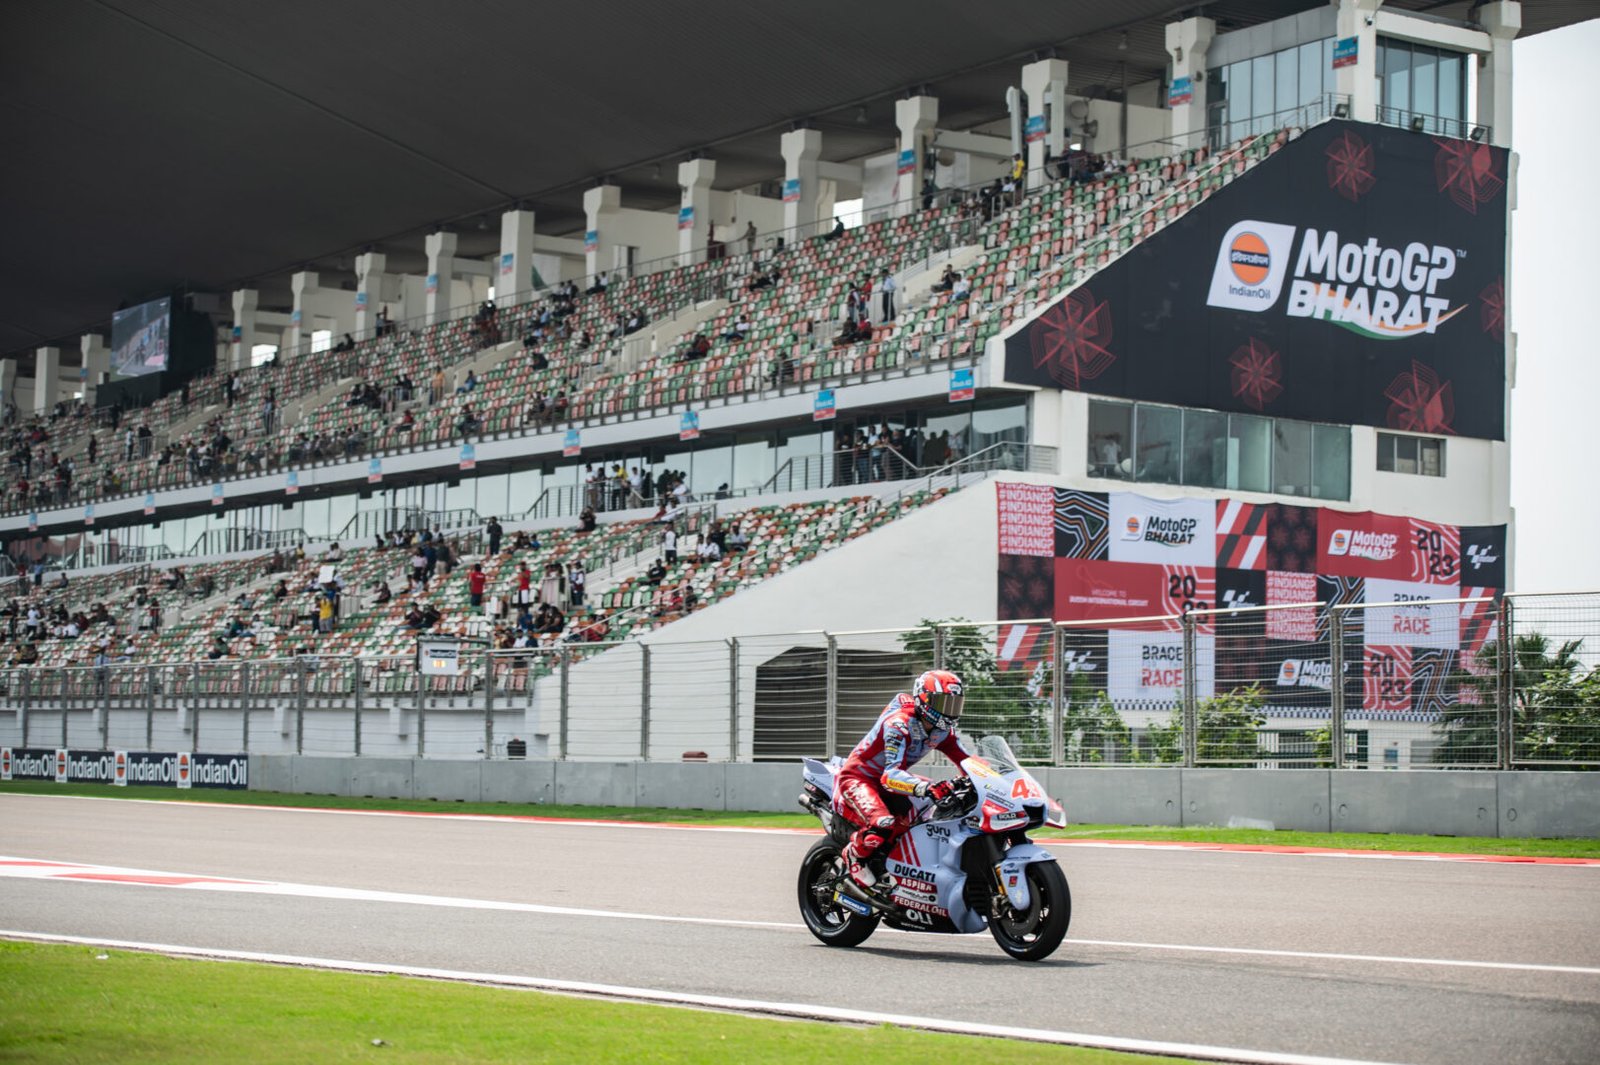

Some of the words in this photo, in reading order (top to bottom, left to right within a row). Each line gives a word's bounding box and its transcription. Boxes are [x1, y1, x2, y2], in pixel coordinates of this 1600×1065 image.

[1294, 228, 1456, 294] MotoGP
[1229, 284, 1271, 299] IndianOil
[1287, 280, 1450, 335] BHARAT
[1147, 516, 1197, 532] MotoGP
[1145, 531, 1195, 544] BHARAT
[1352, 530, 1397, 549] MotoGP
[1416, 529, 1442, 551] 20
[1429, 554, 1455, 576] 23
[1170, 574, 1196, 599] 20
[1392, 615, 1431, 635] RACE
[1142, 645, 1183, 661] BRACE
[1370, 653, 1394, 677] 20
[1142, 668, 1184, 687] RACE
[1381, 679, 1406, 701] 23
[12, 754, 55, 776] IndianOil
[68, 755, 114, 780] IndianOil
[128, 757, 177, 782] IndianOil
[192, 758, 247, 784] IndianOil
[926, 824, 951, 837] guru
[894, 863, 936, 883] DUCATI
[901, 878, 932, 891] ASPIRA
[895, 896, 930, 913] FEDERAL
[931, 905, 947, 917] OIL
